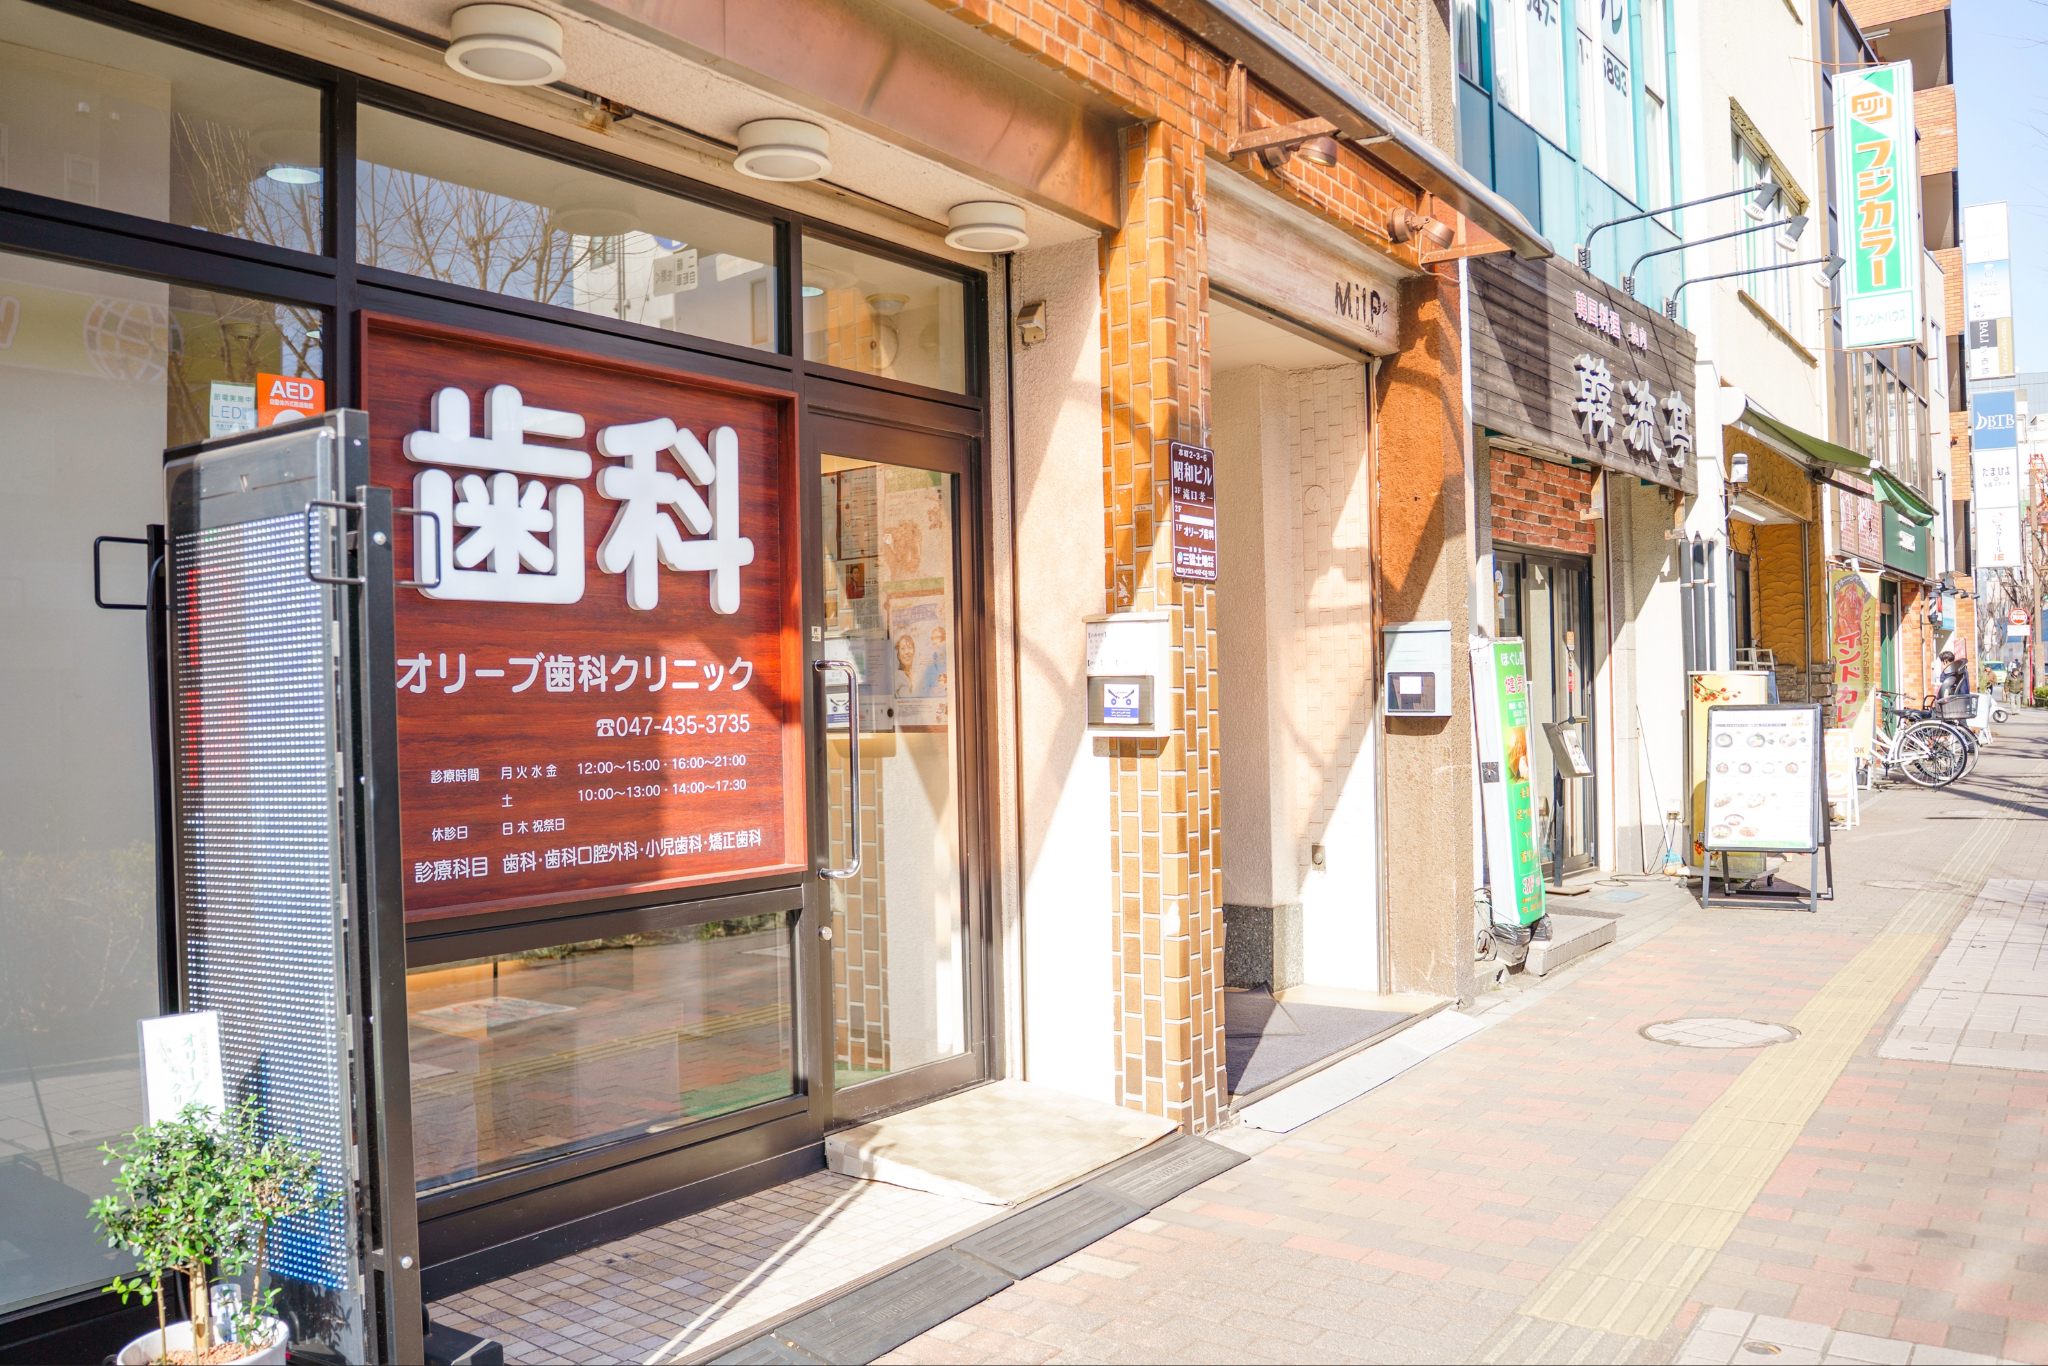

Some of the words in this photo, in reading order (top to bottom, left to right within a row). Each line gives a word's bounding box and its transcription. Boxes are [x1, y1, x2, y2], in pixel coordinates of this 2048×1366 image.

[1855, 138, 1897, 286] フジカラー
[1575, 290, 1621, 339] 韓国料理
[269, 380, 314, 401] AED
[1173, 460, 1213, 487] 昭和ビル
[1982, 466, 2011, 477] たまひよ
[402, 384, 755, 615] 歯科
[396, 651, 753, 694] オリーブ歯科クリニック
[1836, 629, 1862, 729] インドカレ
[615, 713, 751, 737] 047-435-3735
[430, 767, 480, 784] 診療時間
[501, 794, 513, 807] 土
[432, 825, 468, 842] 休診日
[414, 856, 488, 883] 診療科目
